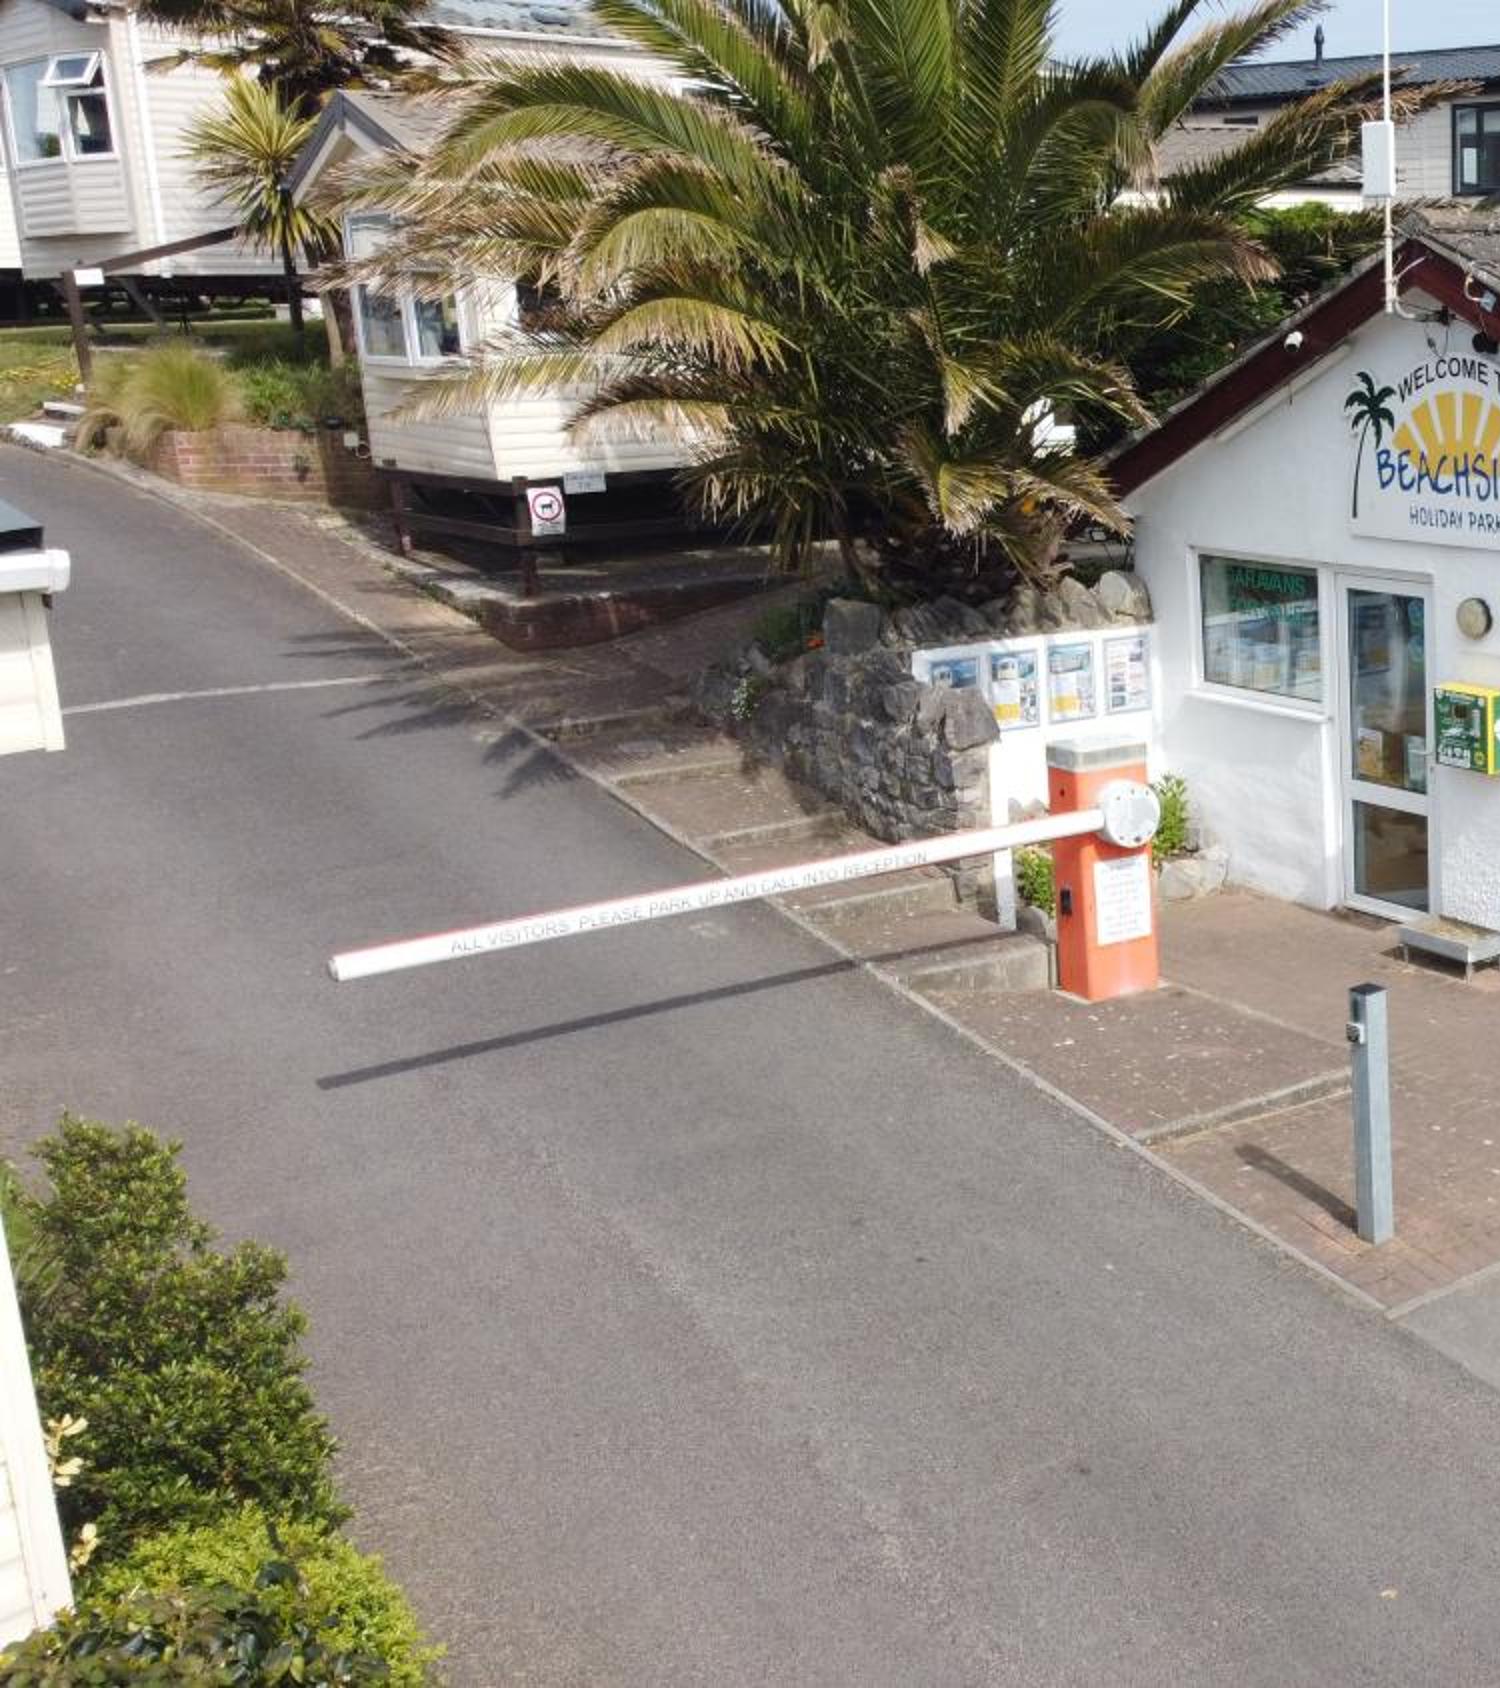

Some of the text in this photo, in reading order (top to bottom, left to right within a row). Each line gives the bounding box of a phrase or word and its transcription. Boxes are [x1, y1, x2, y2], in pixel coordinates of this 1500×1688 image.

[1397, 357, 1489, 404] WELCOME
[1409, 505, 1463, 530] HOLIDAY
[450, 851, 928, 953] ALL VISITORS PLEASE PARK UP AND CALL INTO RECEPTION
